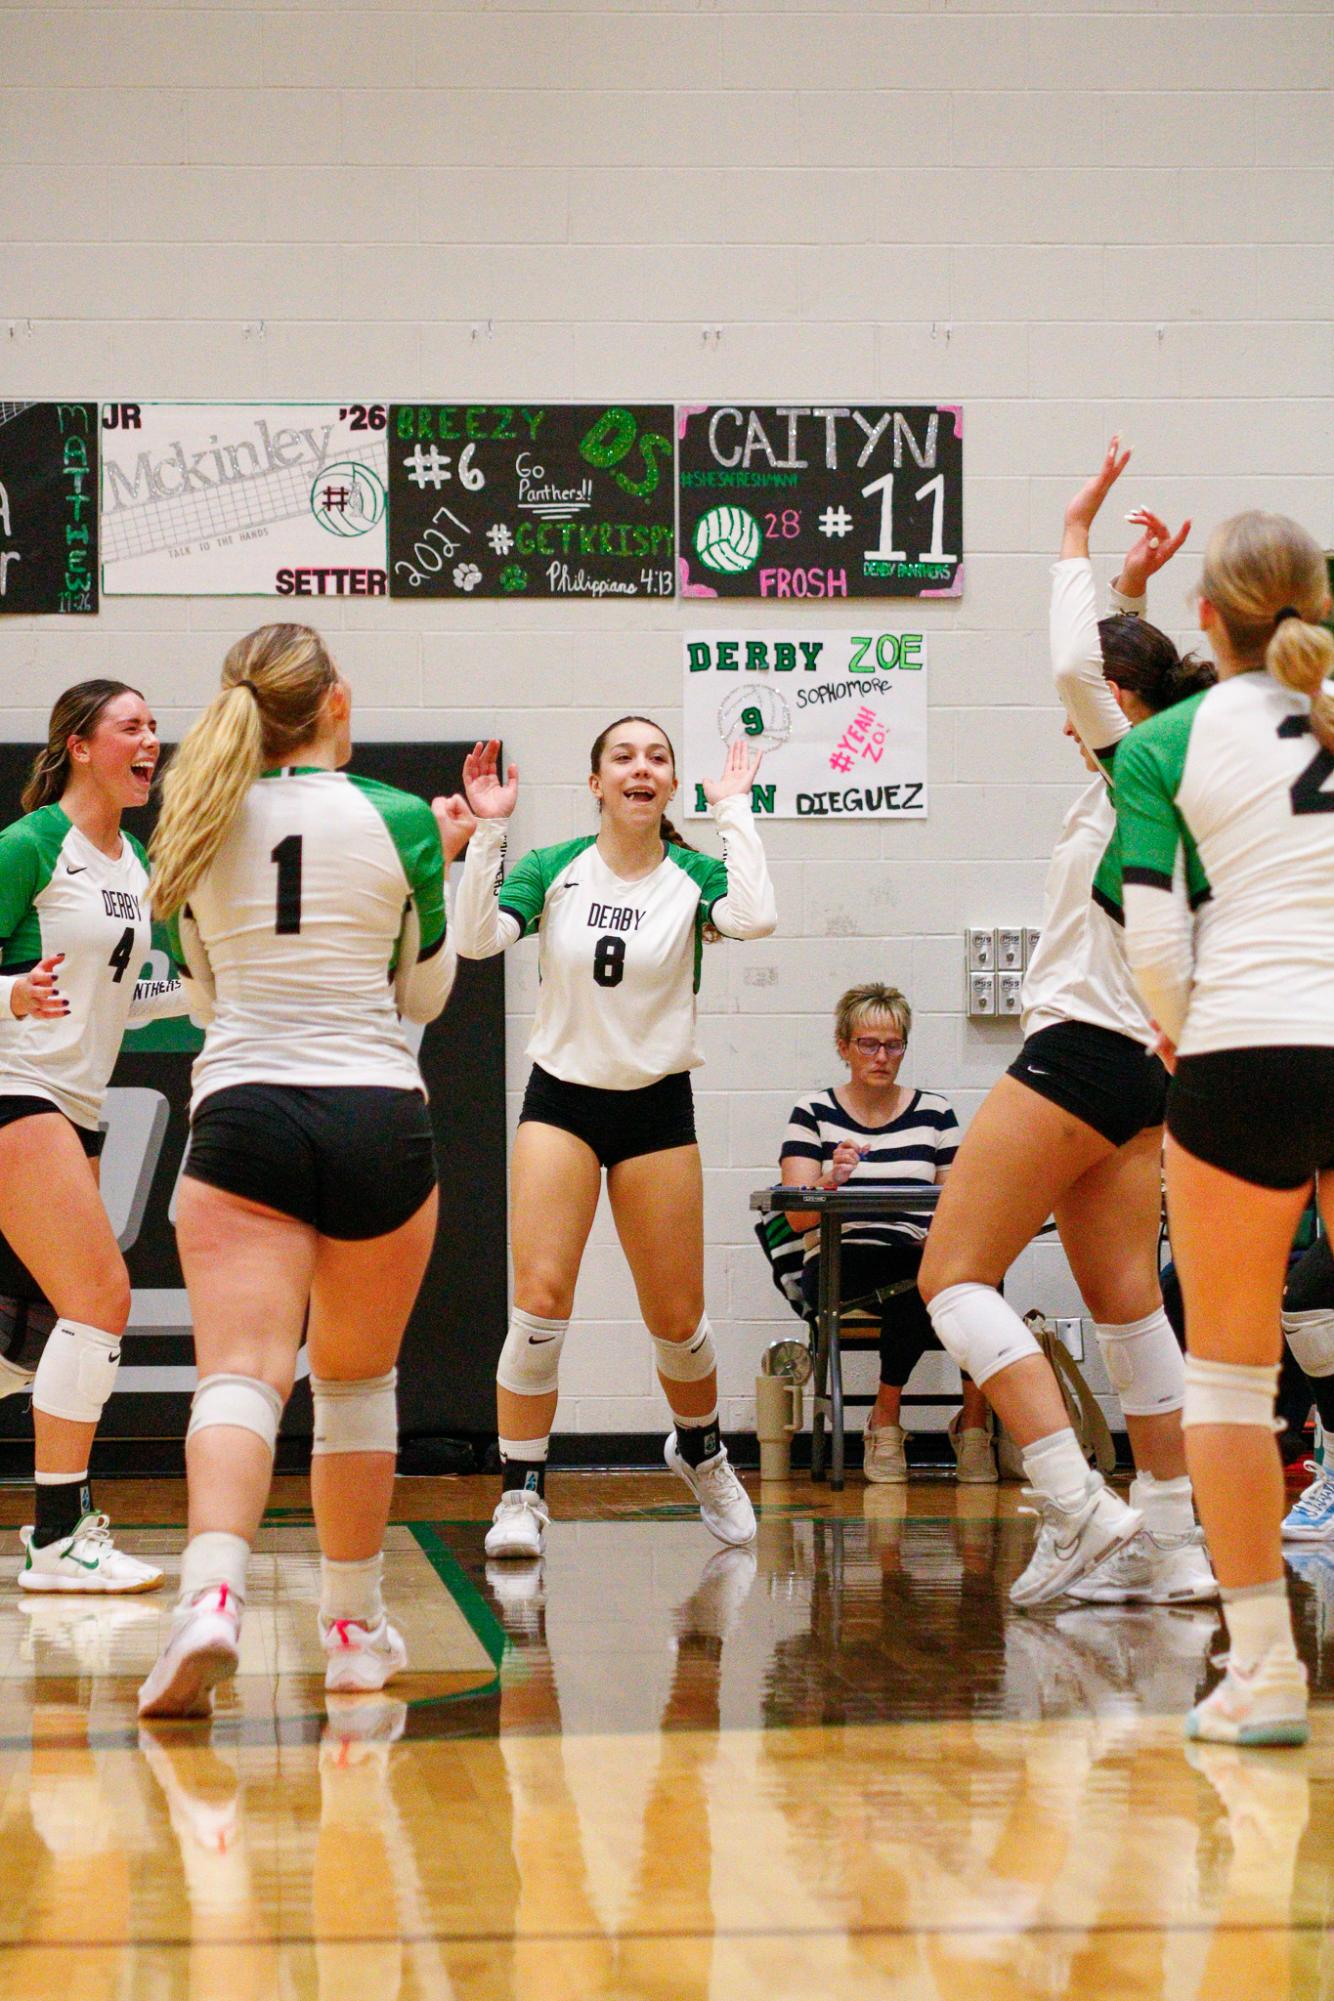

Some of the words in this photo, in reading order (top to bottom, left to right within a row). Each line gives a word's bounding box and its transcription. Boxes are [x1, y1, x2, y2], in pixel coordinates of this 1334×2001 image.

[102, 403, 142, 429] JR
[397, 406, 546, 440] BREEZY
[104, 419, 335, 512] Mckinley
[515, 452, 545, 479] Go
[168, 546, 192, 559] TALK
[199, 541, 210, 552] TO
[216, 534, 233, 548] THE
[239, 527, 270, 543] HANDS
[394, 506, 471, 586] 2027
[275, 569, 388, 596] SETTER
[546, 560, 638, 598] Philippians
[640, 567, 673, 596] 4:13
[760, 567, 848, 598] FROSH
[687, 641, 823, 672] DERBY
[849, 633, 923, 673] ZOE
[741, 706, 764, 736] 9
[829, 705, 877, 773] #YEAH
[796, 783, 924, 815] DIEGUEZ
[271, 834, 303, 935] 1
[101, 889, 142, 922] DERBY
[587, 903, 647, 931] DERBY
[108, 927, 135, 983] 4
[593, 935, 626, 988] 8
[132, 980, 182, 1001] NTHERS
